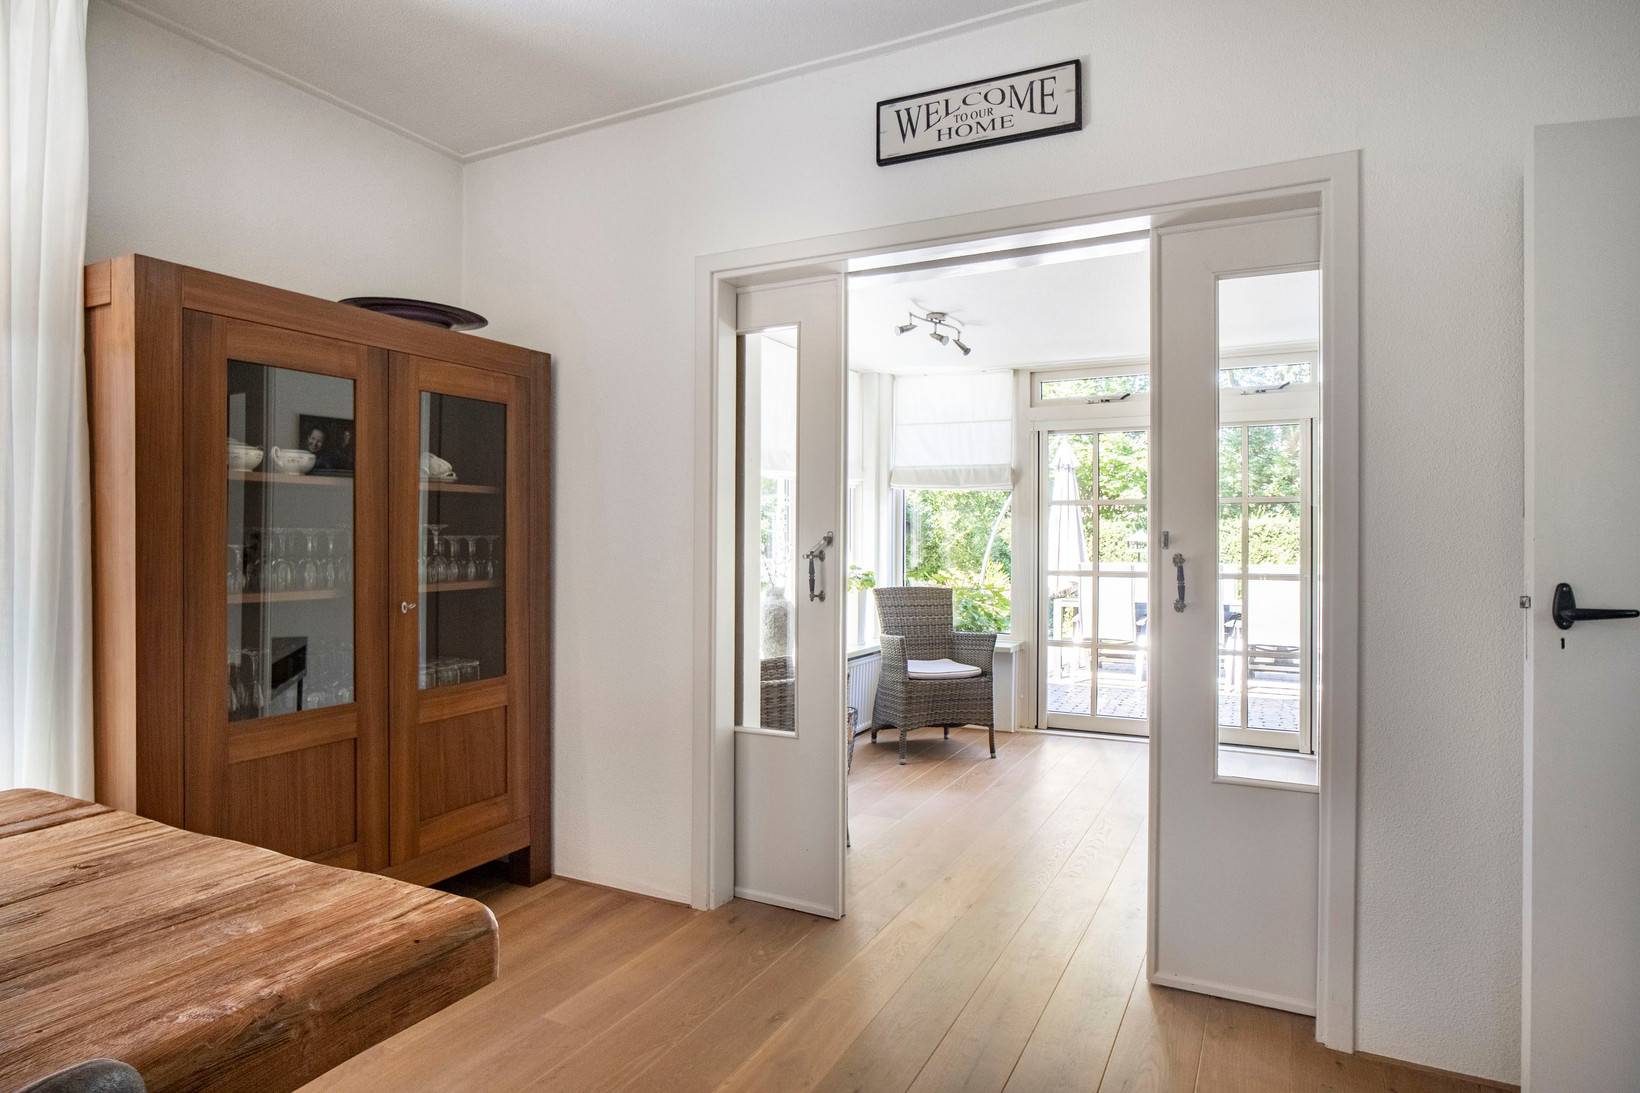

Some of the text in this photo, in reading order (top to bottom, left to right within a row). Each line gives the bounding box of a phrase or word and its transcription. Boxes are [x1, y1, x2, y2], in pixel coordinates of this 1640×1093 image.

[894, 76, 1059, 144] WELCOME
[953, 107, 994, 124] TO OUR
[936, 114, 1015, 142] HOME
